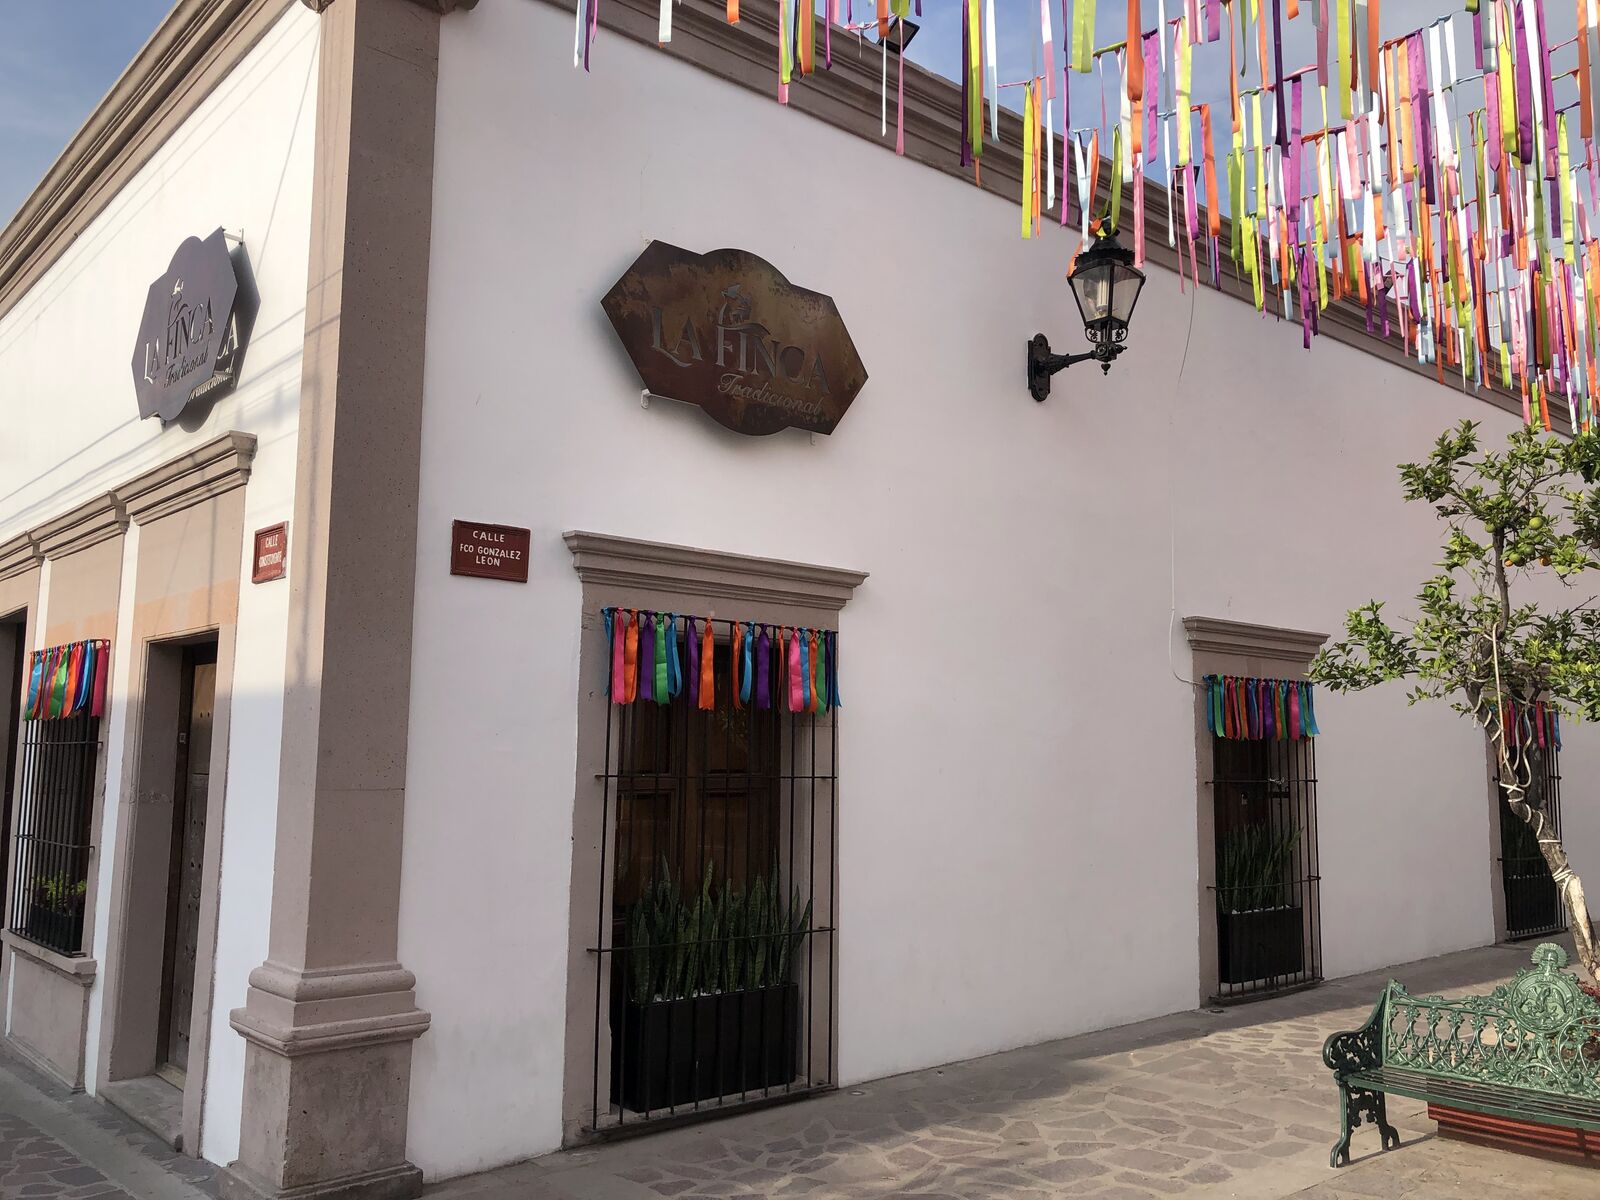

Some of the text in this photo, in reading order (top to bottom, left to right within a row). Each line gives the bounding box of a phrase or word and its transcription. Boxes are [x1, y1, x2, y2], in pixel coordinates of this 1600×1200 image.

[143, 337, 160, 384] LA
[164, 297, 215, 365] FINCA
[652, 307, 831, 393] LA FINCA
[717, 373, 824, 416] Tradicional
[472, 530, 505, 542] CALLE
[460, 543, 521, 560] FCO GONZALEZ
[475, 555, 501, 567] LEON
